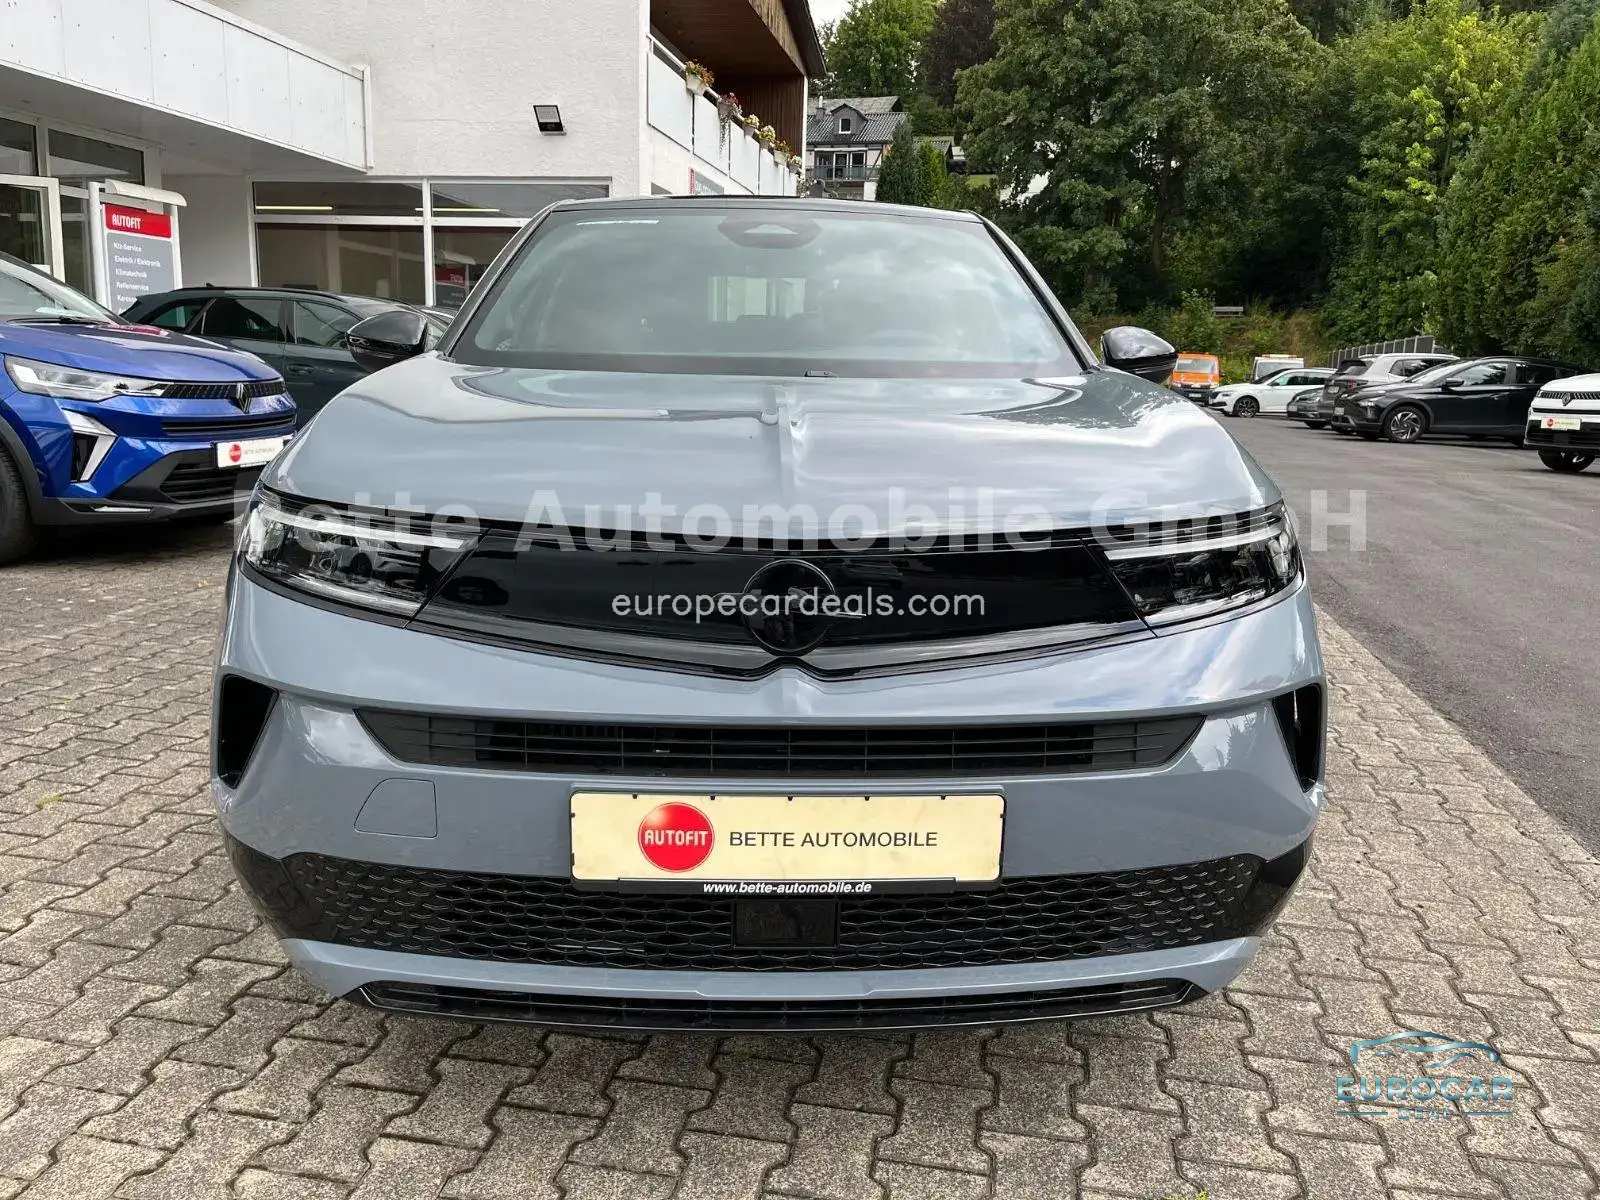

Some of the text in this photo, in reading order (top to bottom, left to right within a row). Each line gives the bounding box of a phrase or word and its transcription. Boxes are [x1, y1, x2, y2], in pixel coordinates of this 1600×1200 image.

[112, 213, 142, 230] AUTOFIT
[643, 829, 938, 848] AUTOFIT BETTE AUTOMOBILE
[702, 881, 872, 895] www.bette-automobile.de
